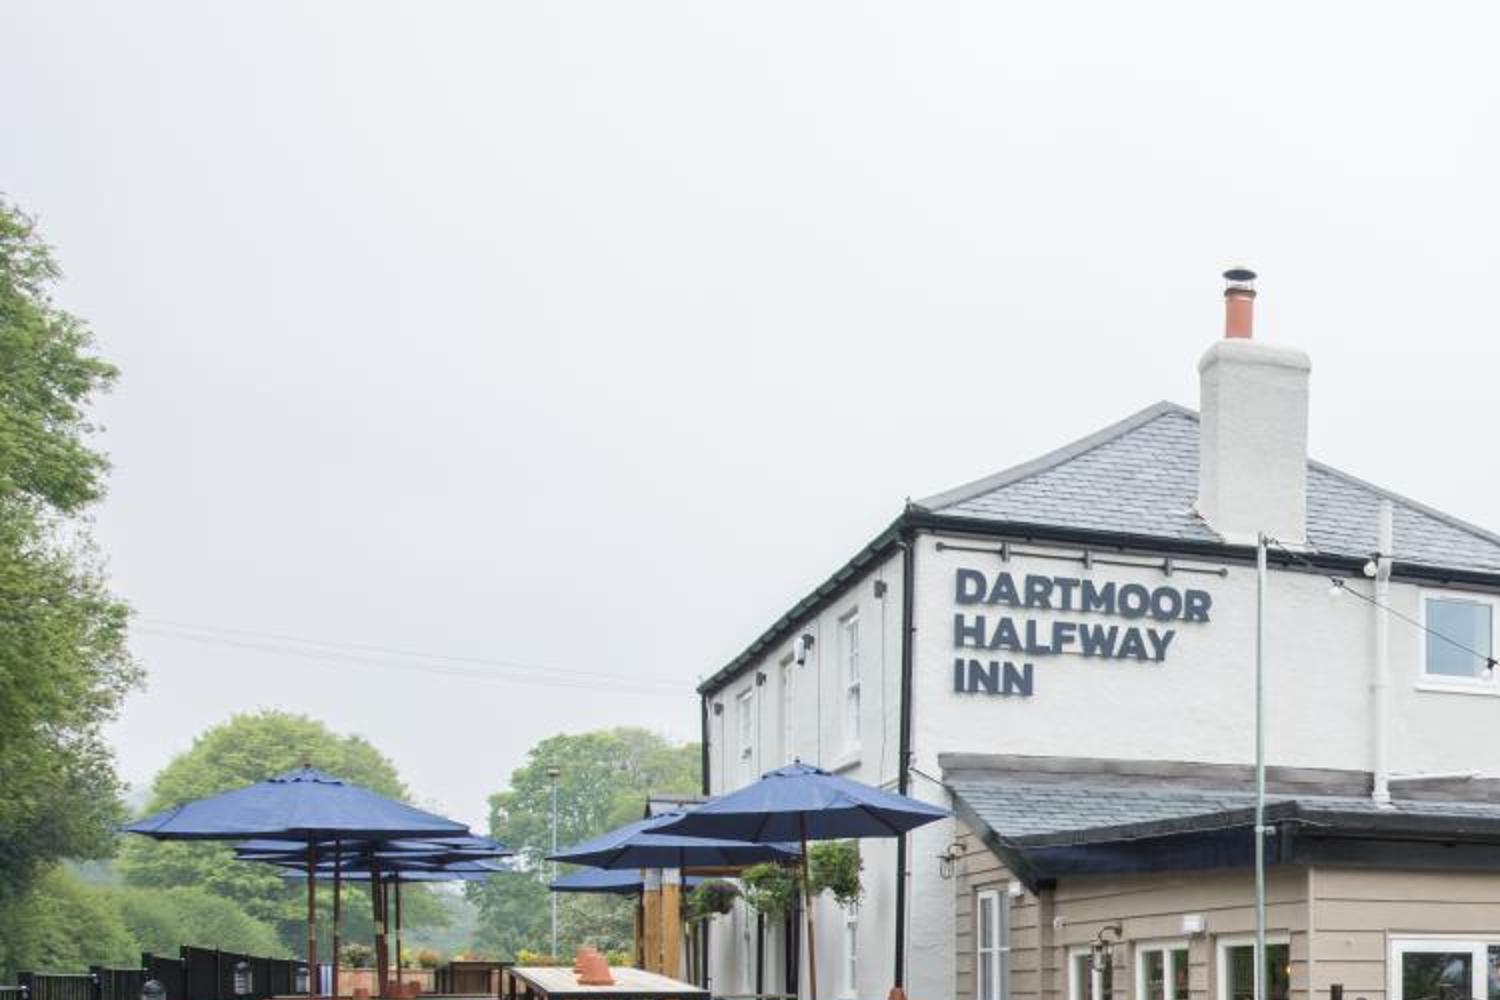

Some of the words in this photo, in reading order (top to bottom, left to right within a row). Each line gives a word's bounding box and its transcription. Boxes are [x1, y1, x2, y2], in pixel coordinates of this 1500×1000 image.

[956, 568, 1212, 623] DARTMOOR
[954, 614, 1174, 662] HALFWAY
[954, 658, 1033, 697] INN
